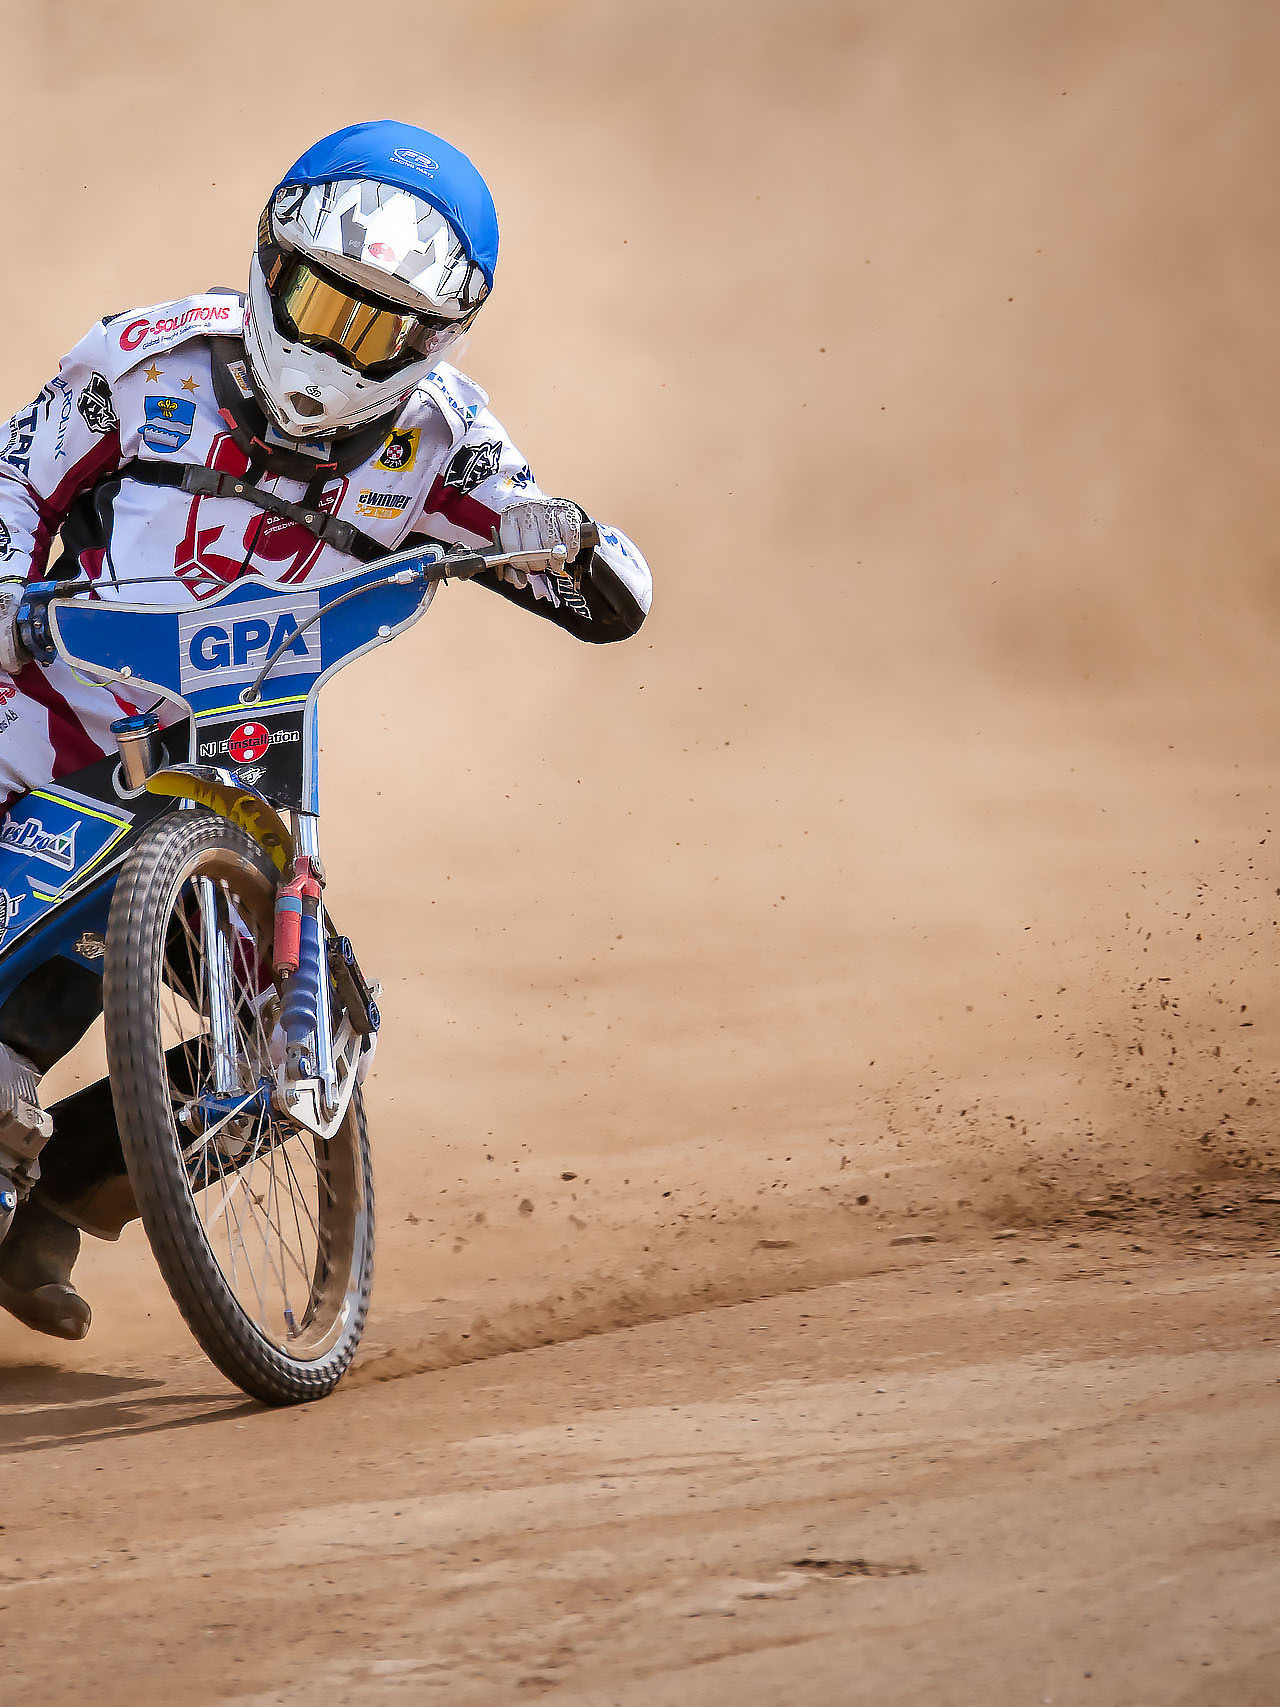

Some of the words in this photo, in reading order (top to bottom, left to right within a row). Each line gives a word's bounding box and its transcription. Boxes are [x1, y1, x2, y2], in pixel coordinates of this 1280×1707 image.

[119, 307, 230, 351] G-SOLUTIONS
[189, 613, 310, 671] GPA
[201, 743, 216, 757] NJ
